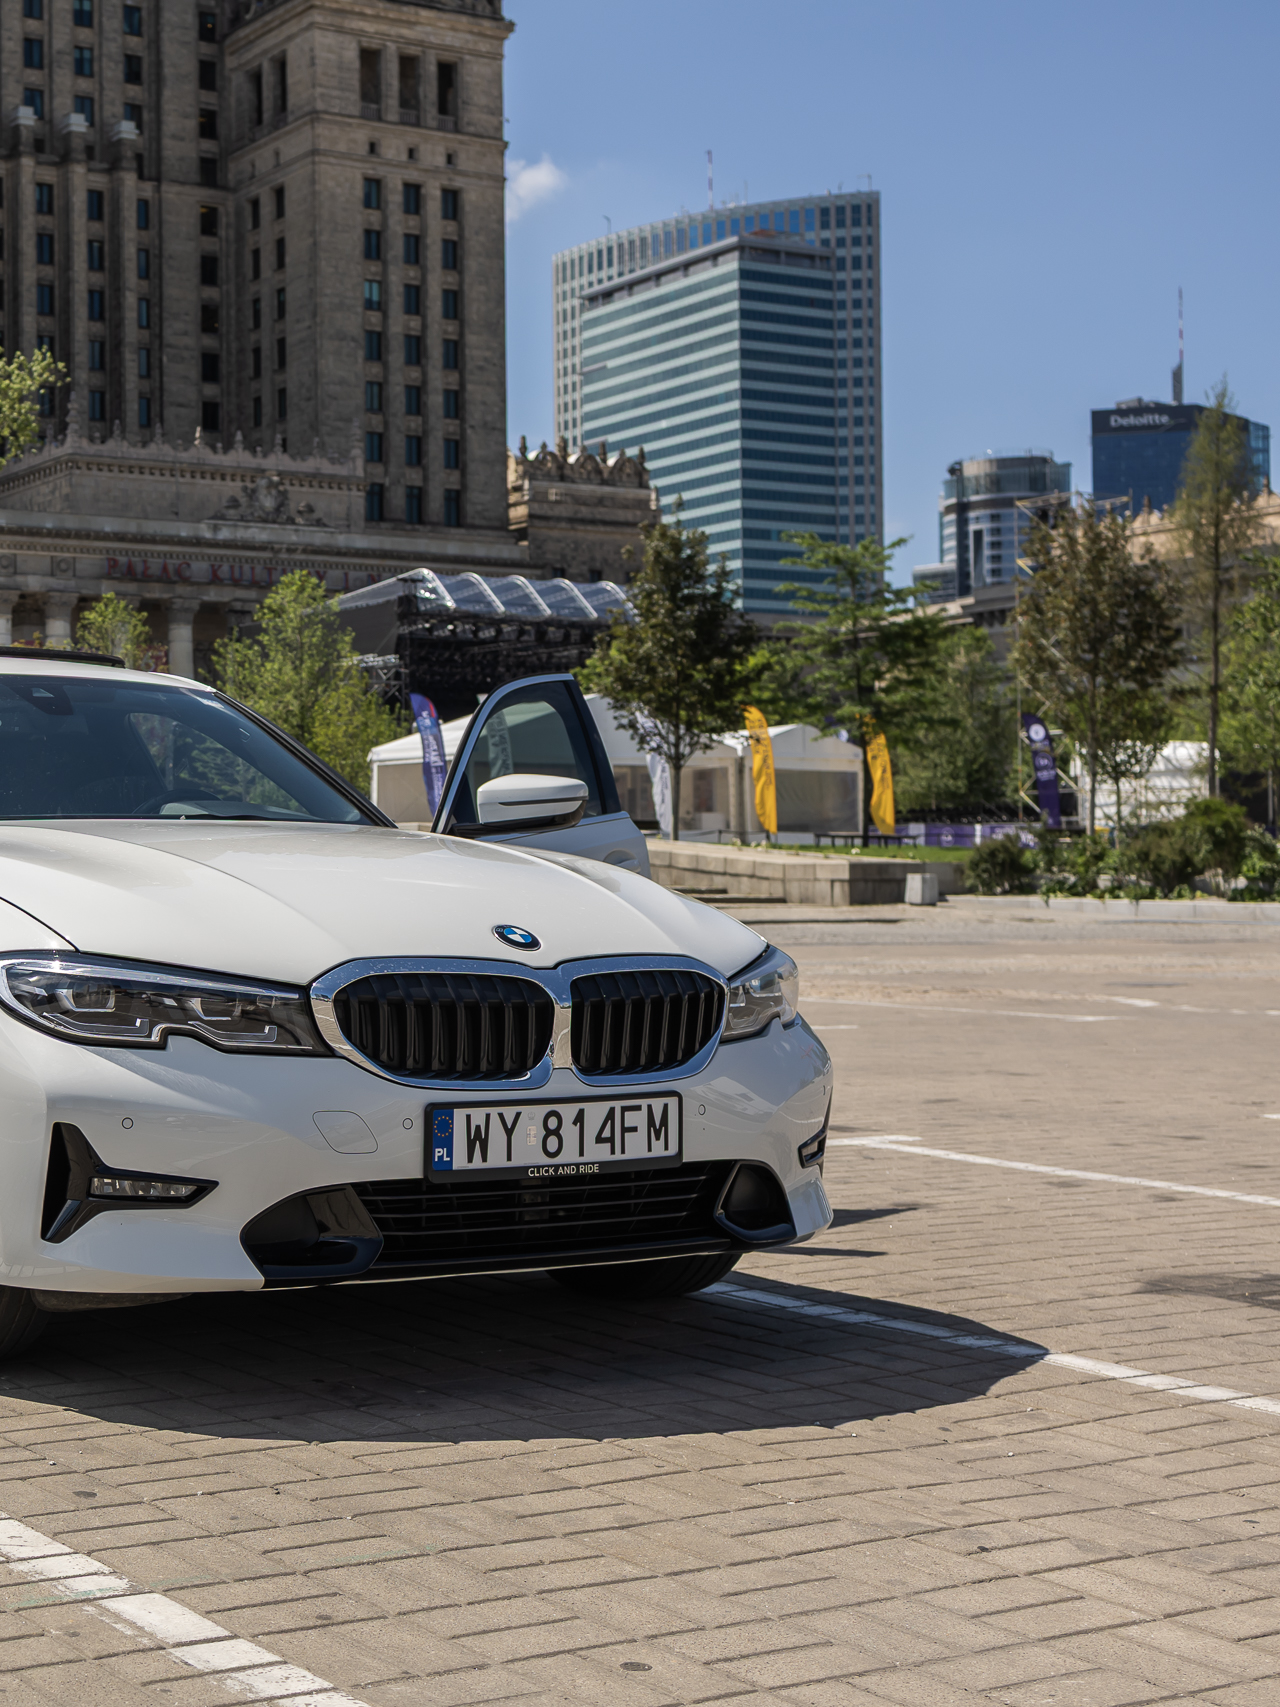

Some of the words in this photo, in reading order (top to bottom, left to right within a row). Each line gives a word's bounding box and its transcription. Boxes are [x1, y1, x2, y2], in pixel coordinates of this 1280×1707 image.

[106, 557, 192, 580] PAŁAC
[465, 1111, 523, 1164] WY
[541, 1102, 669, 1159] 814FM
[434, 1147, 451, 1162] PL
[528, 1166, 555, 1177] CLICK
[557, 1165, 577, 1175] AND
[579, 1163, 600, 1174] RIDE
